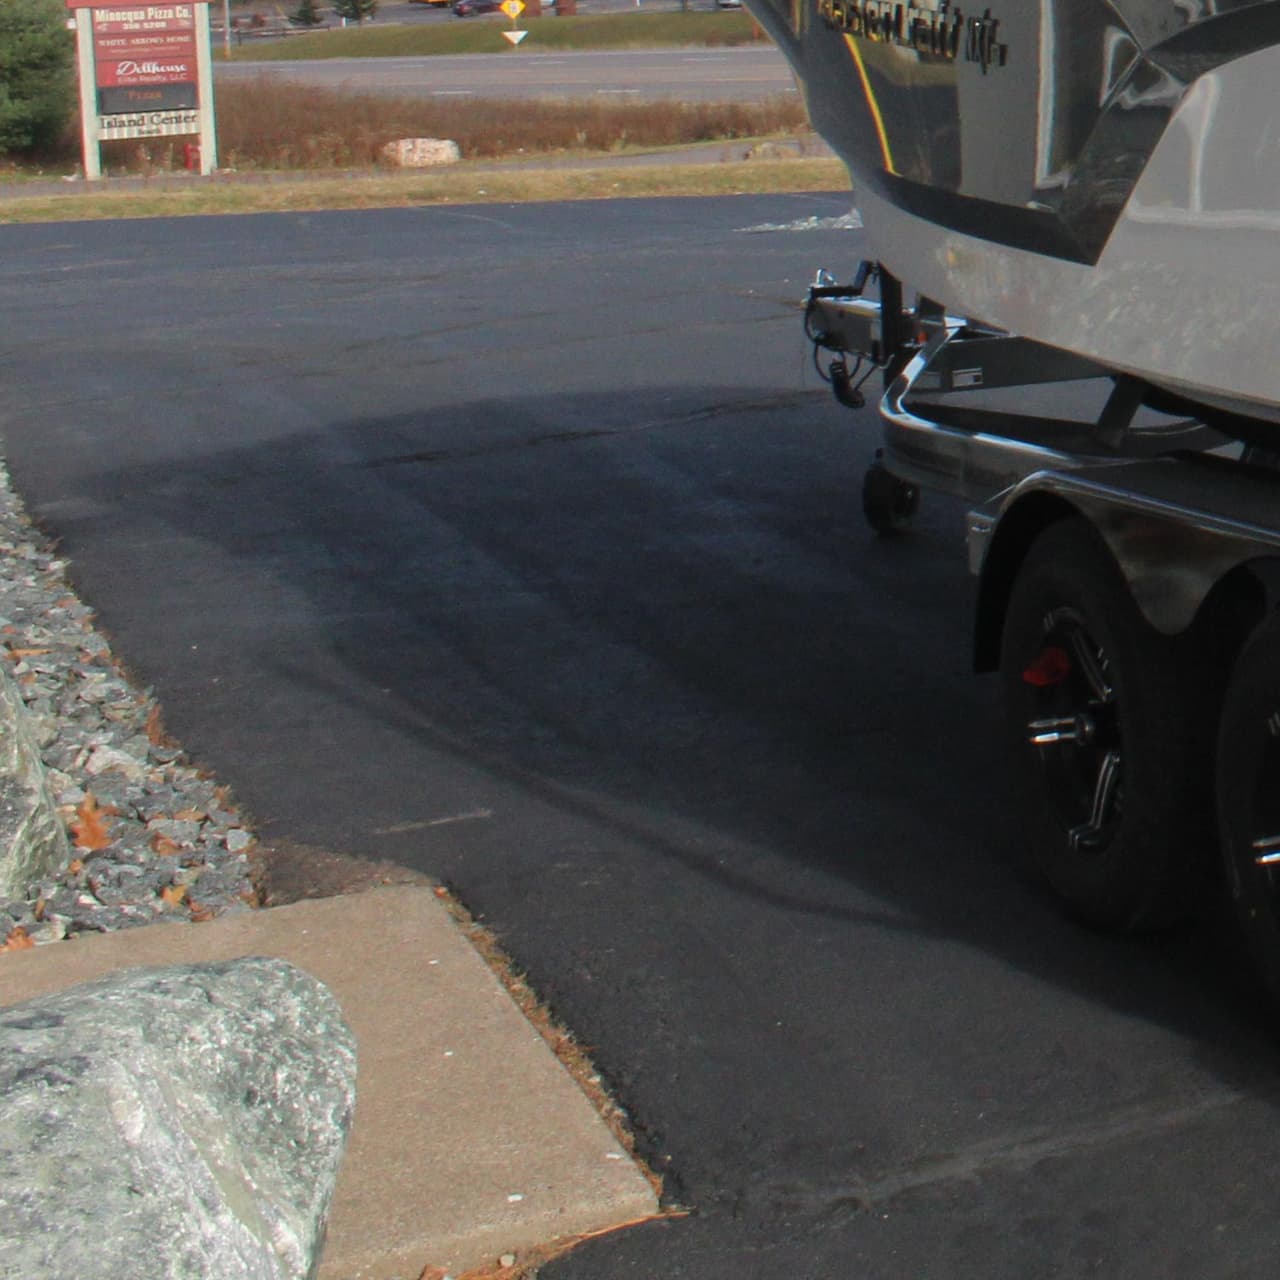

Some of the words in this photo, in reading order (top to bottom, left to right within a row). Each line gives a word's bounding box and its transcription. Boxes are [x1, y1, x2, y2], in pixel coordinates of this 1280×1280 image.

[96, 8, 145, 22] Minocqua
[147, 7, 174, 19] Pizza
[176, 5, 193, 18] Co.
[116, 61, 187, 75] Dollhouse
[101, 116, 145, 129] Island
[150, 113, 198, 125] Center
